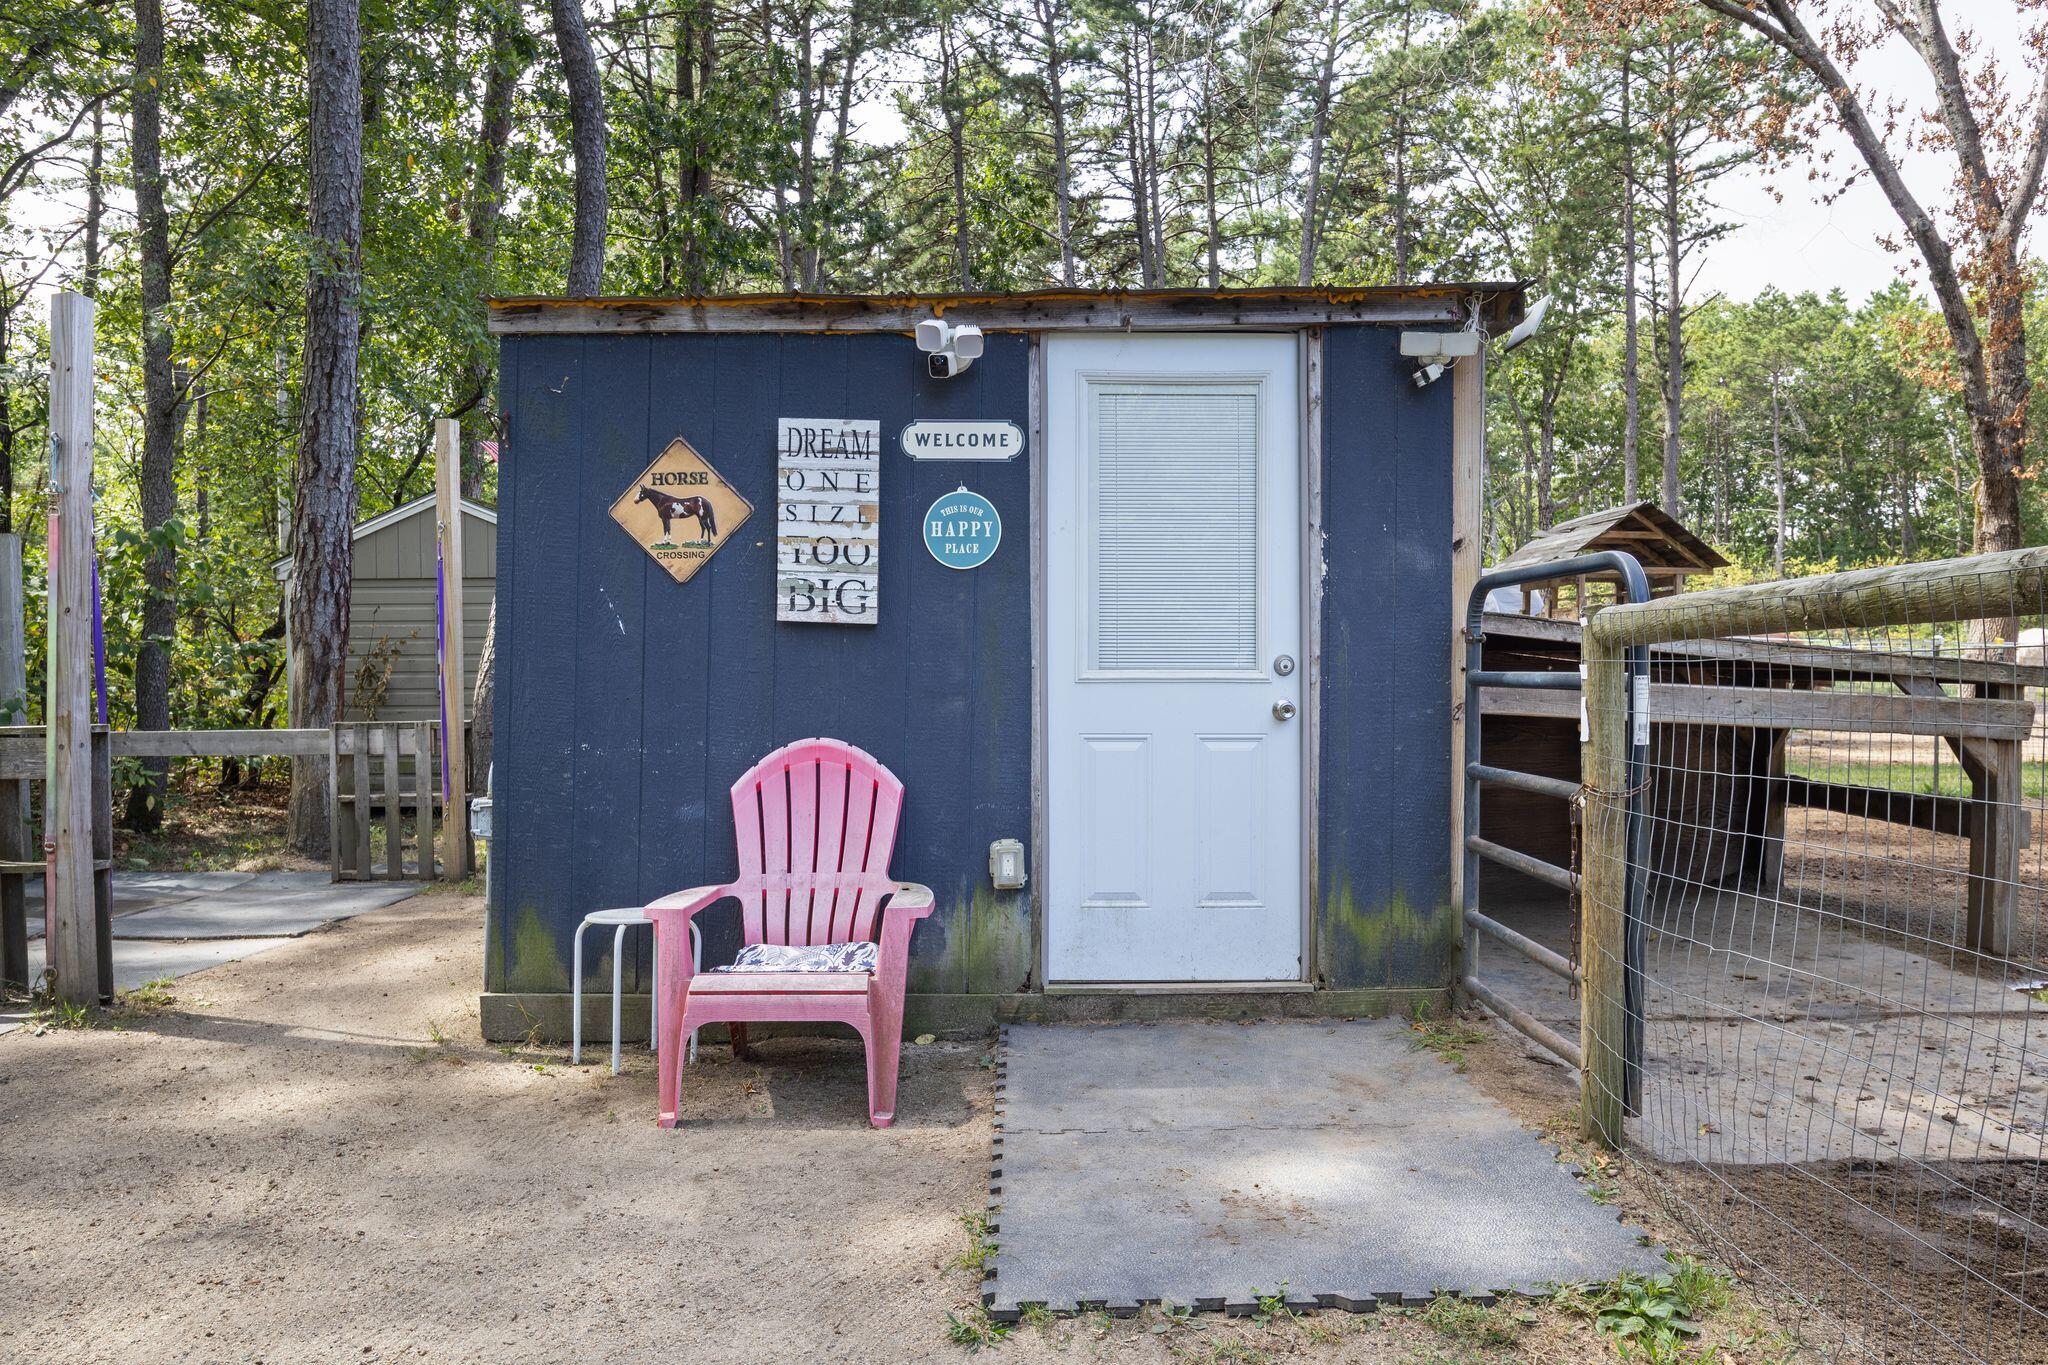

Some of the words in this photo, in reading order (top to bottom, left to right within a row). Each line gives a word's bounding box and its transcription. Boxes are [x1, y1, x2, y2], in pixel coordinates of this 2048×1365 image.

[786, 427, 872, 461] DREAM
[914, 432, 1009, 448] WELCOME
[650, 471, 709, 486] HORSE
[786, 470, 872, 494] ONE
[940, 505, 959, 517] THIS
[959, 504, 967, 513] IS
[968, 505, 984, 517] OUR
[930, 521, 993, 538] HAPPY
[656, 551, 705, 560] CROSSING
[785, 535, 871, 567] TOO
[944, 543, 979, 554] PLACE
[786, 577, 871, 615] BIG
